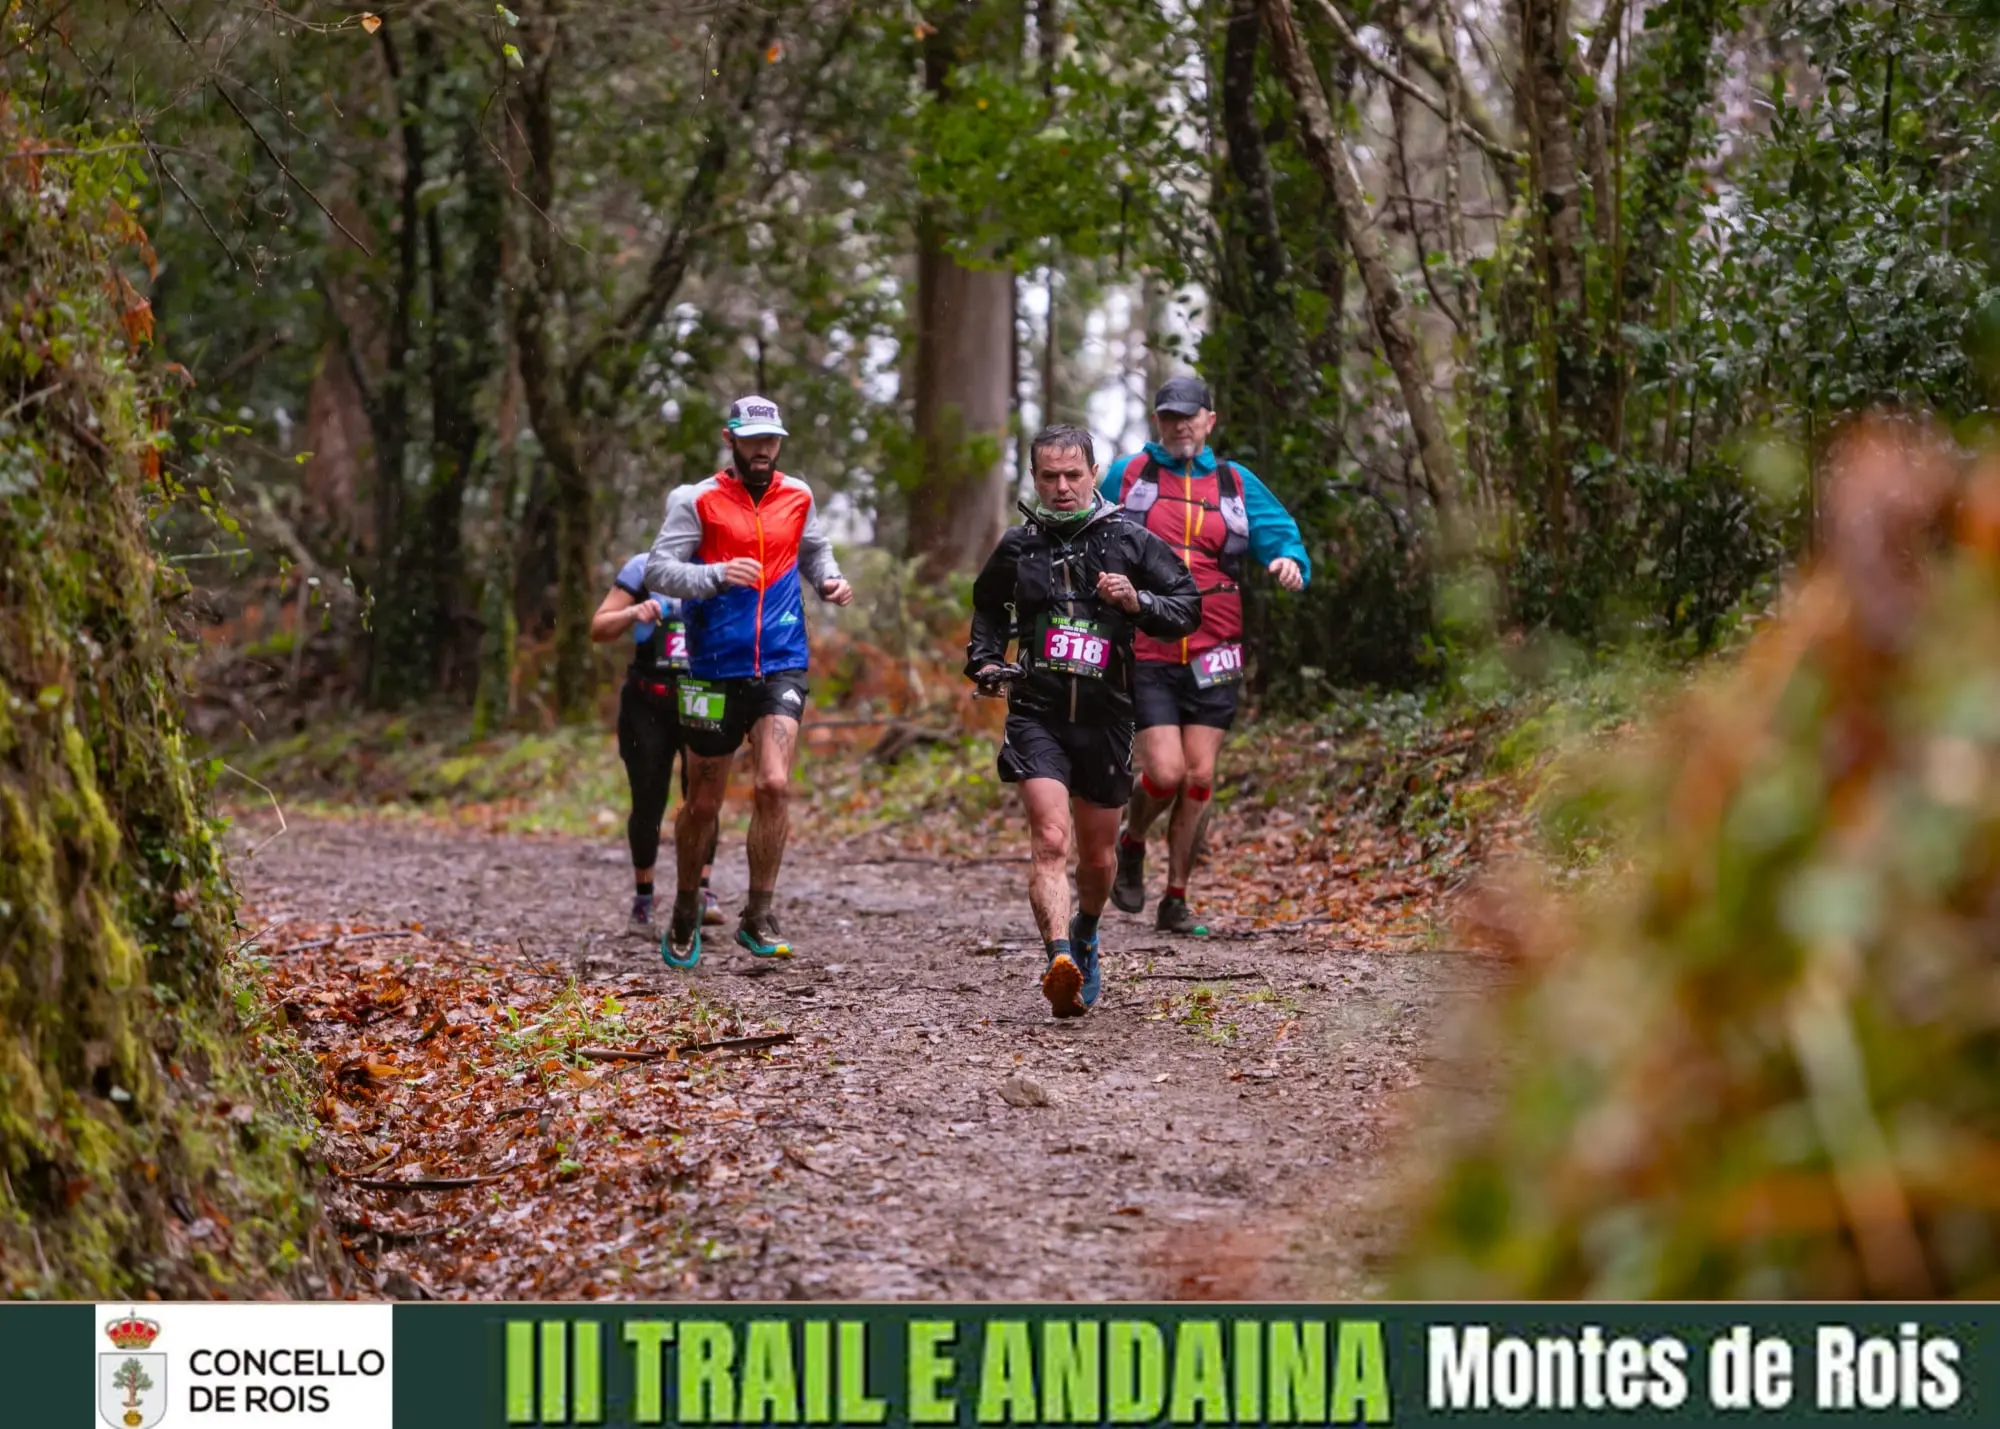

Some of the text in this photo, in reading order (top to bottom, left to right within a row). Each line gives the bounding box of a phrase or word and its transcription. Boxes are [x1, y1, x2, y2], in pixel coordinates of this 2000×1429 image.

[1050, 634, 1103, 664] 318
[1205, 648, 1241, 673] 201
[684, 696, 708, 717] 14
